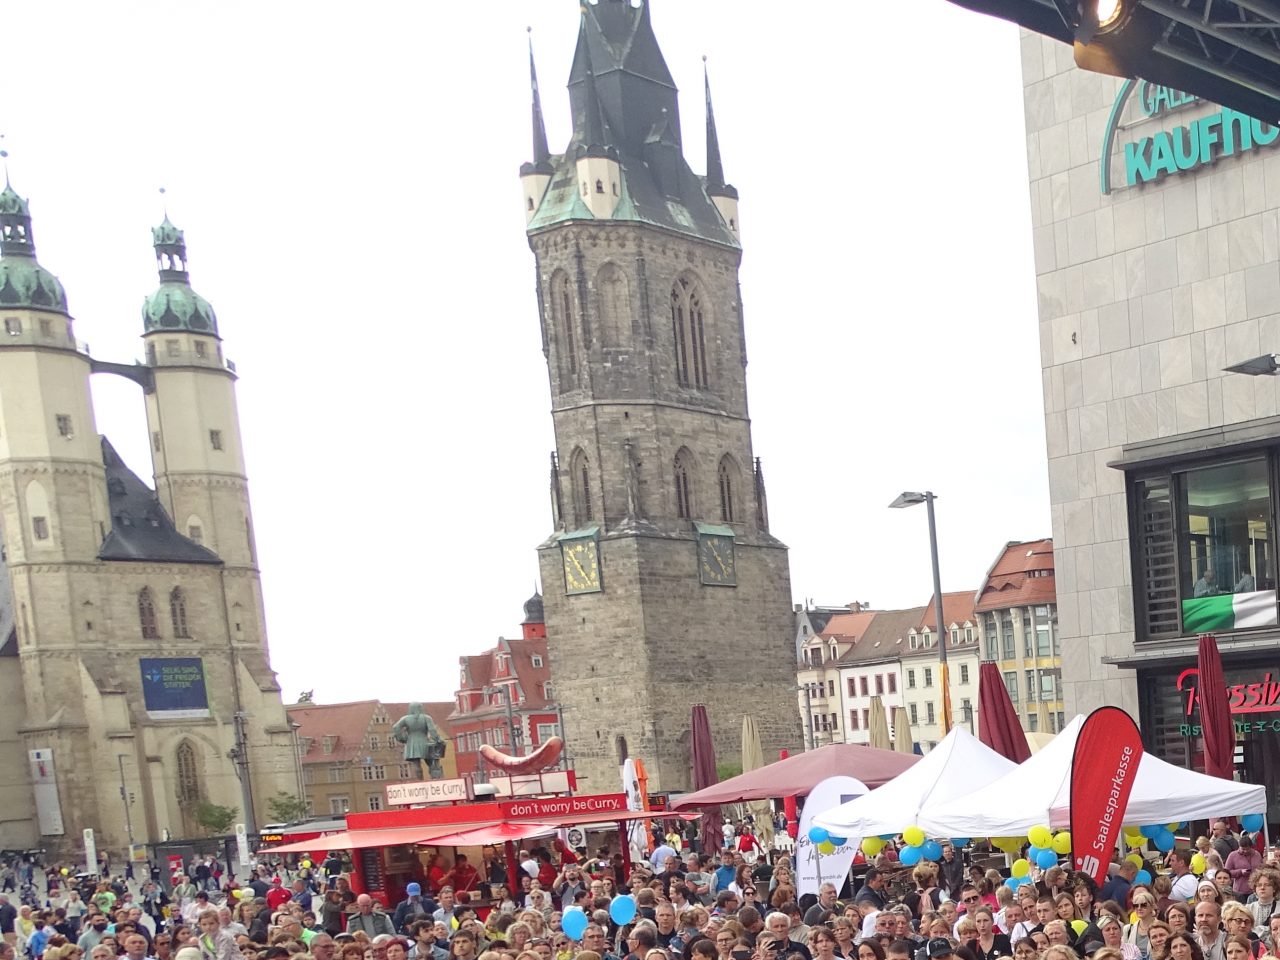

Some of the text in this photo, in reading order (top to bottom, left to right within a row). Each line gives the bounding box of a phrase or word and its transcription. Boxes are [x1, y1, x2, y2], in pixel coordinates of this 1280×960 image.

[408, 786, 429, 799] worry
[431, 783, 441, 795] be
[1093, 746, 1133, 852] Saalesparkasse
[541, 802, 571, 814] worry
